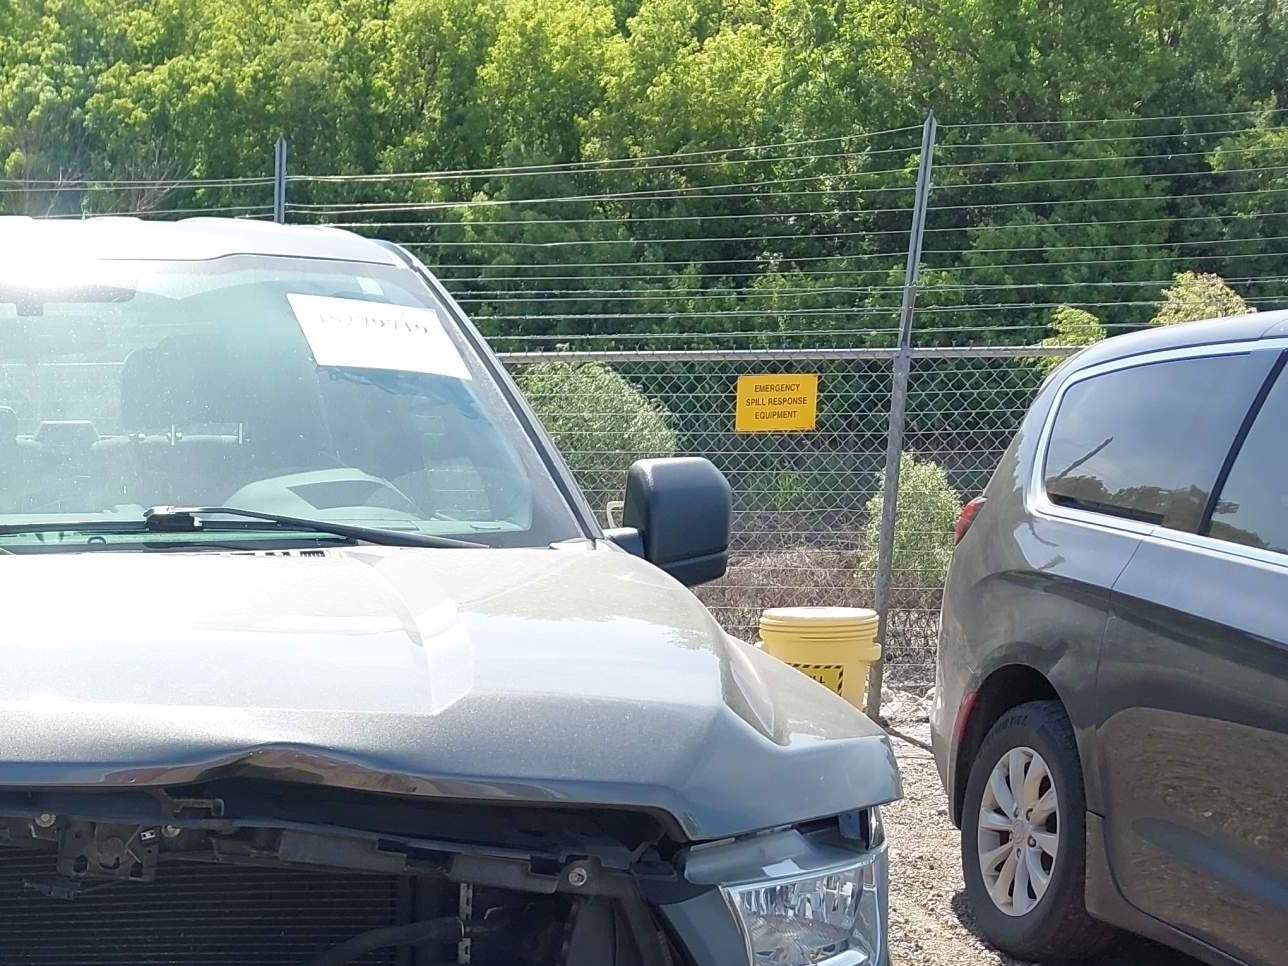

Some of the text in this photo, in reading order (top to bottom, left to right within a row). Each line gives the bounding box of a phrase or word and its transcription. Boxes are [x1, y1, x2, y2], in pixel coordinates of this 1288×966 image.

[754, 383, 801, 393] EMERGENCY
[745, 396, 808, 407] SPILL RESPONSE
[754, 410, 797, 420] EQUIPMENT
